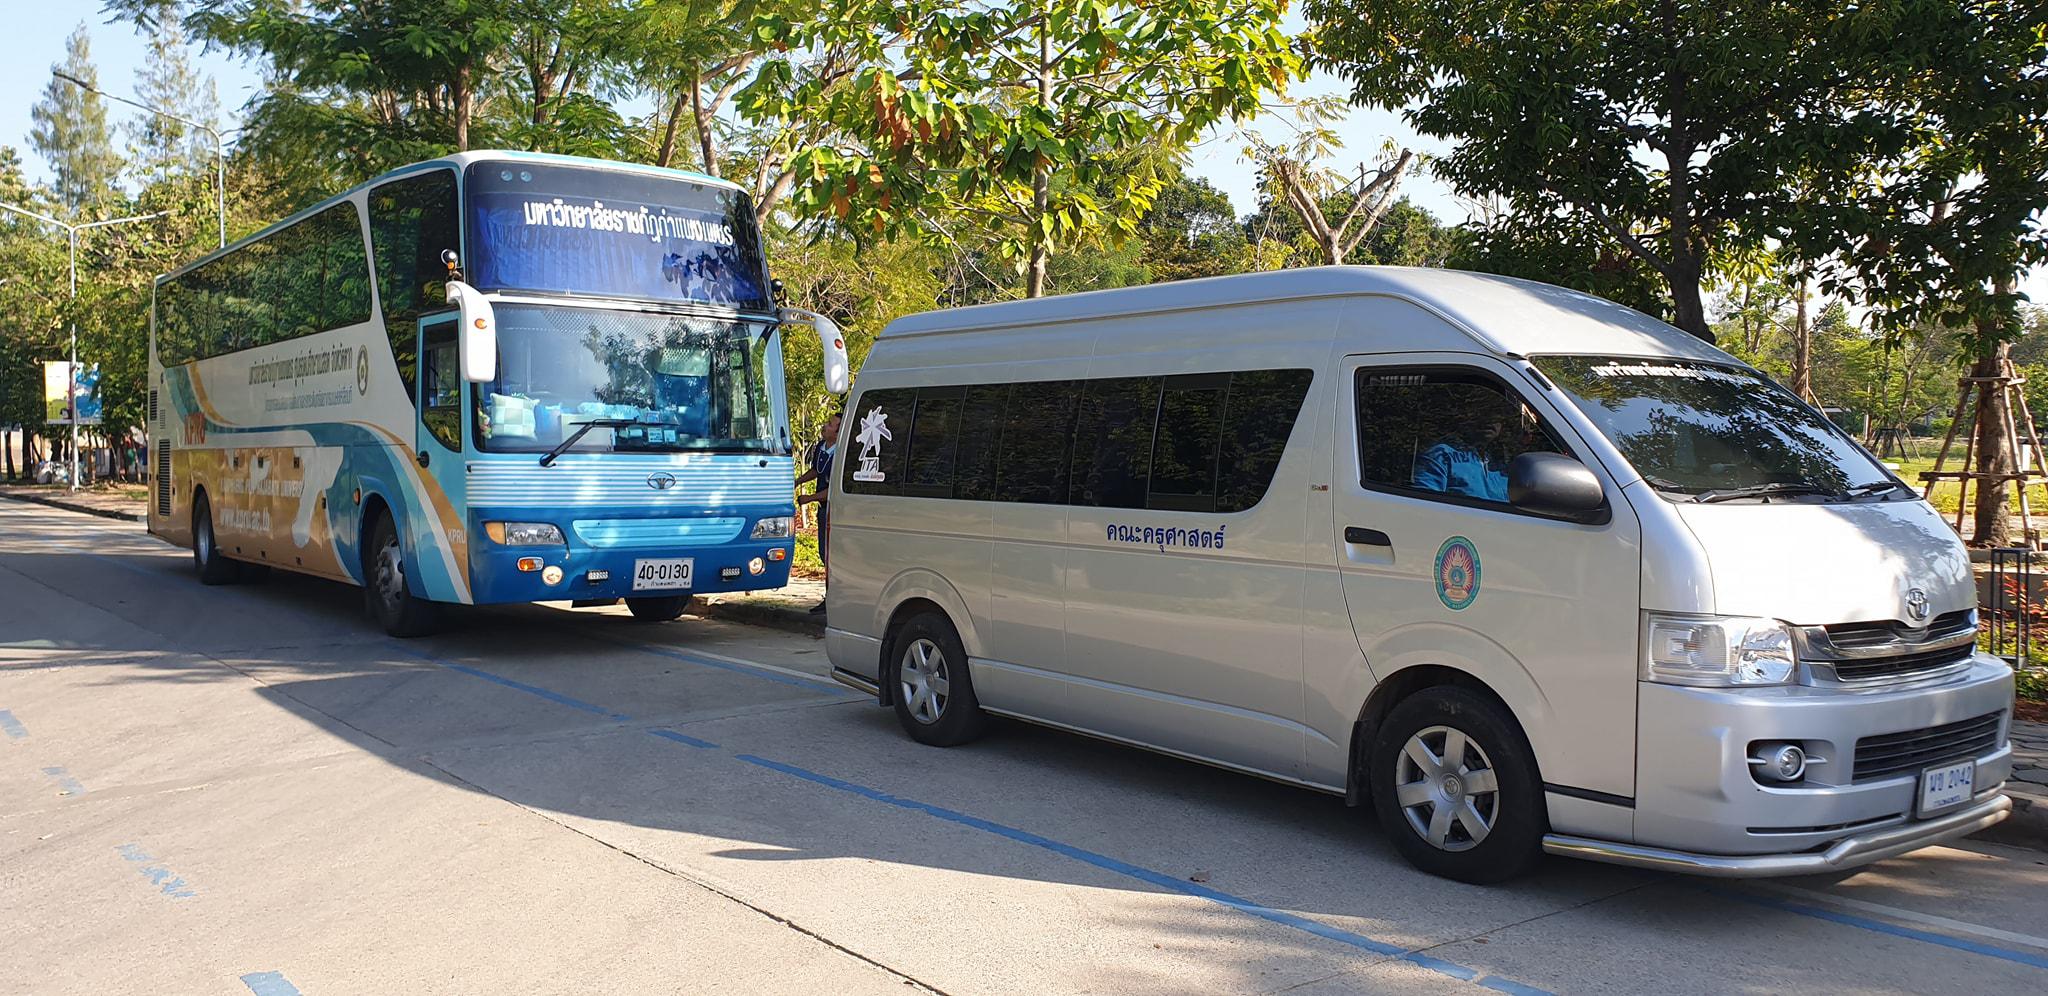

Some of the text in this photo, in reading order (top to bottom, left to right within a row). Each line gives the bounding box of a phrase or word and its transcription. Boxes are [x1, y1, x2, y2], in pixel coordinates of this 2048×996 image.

[523, 199, 733, 246] มหาวิทยาลัยราชภัฏกำแพงเพชร
[447, 527, 466, 545] KPRU
[1106, 523, 1226, 553] คณะครุศาสตร์
[638, 564, 689, 579] 40-0130
